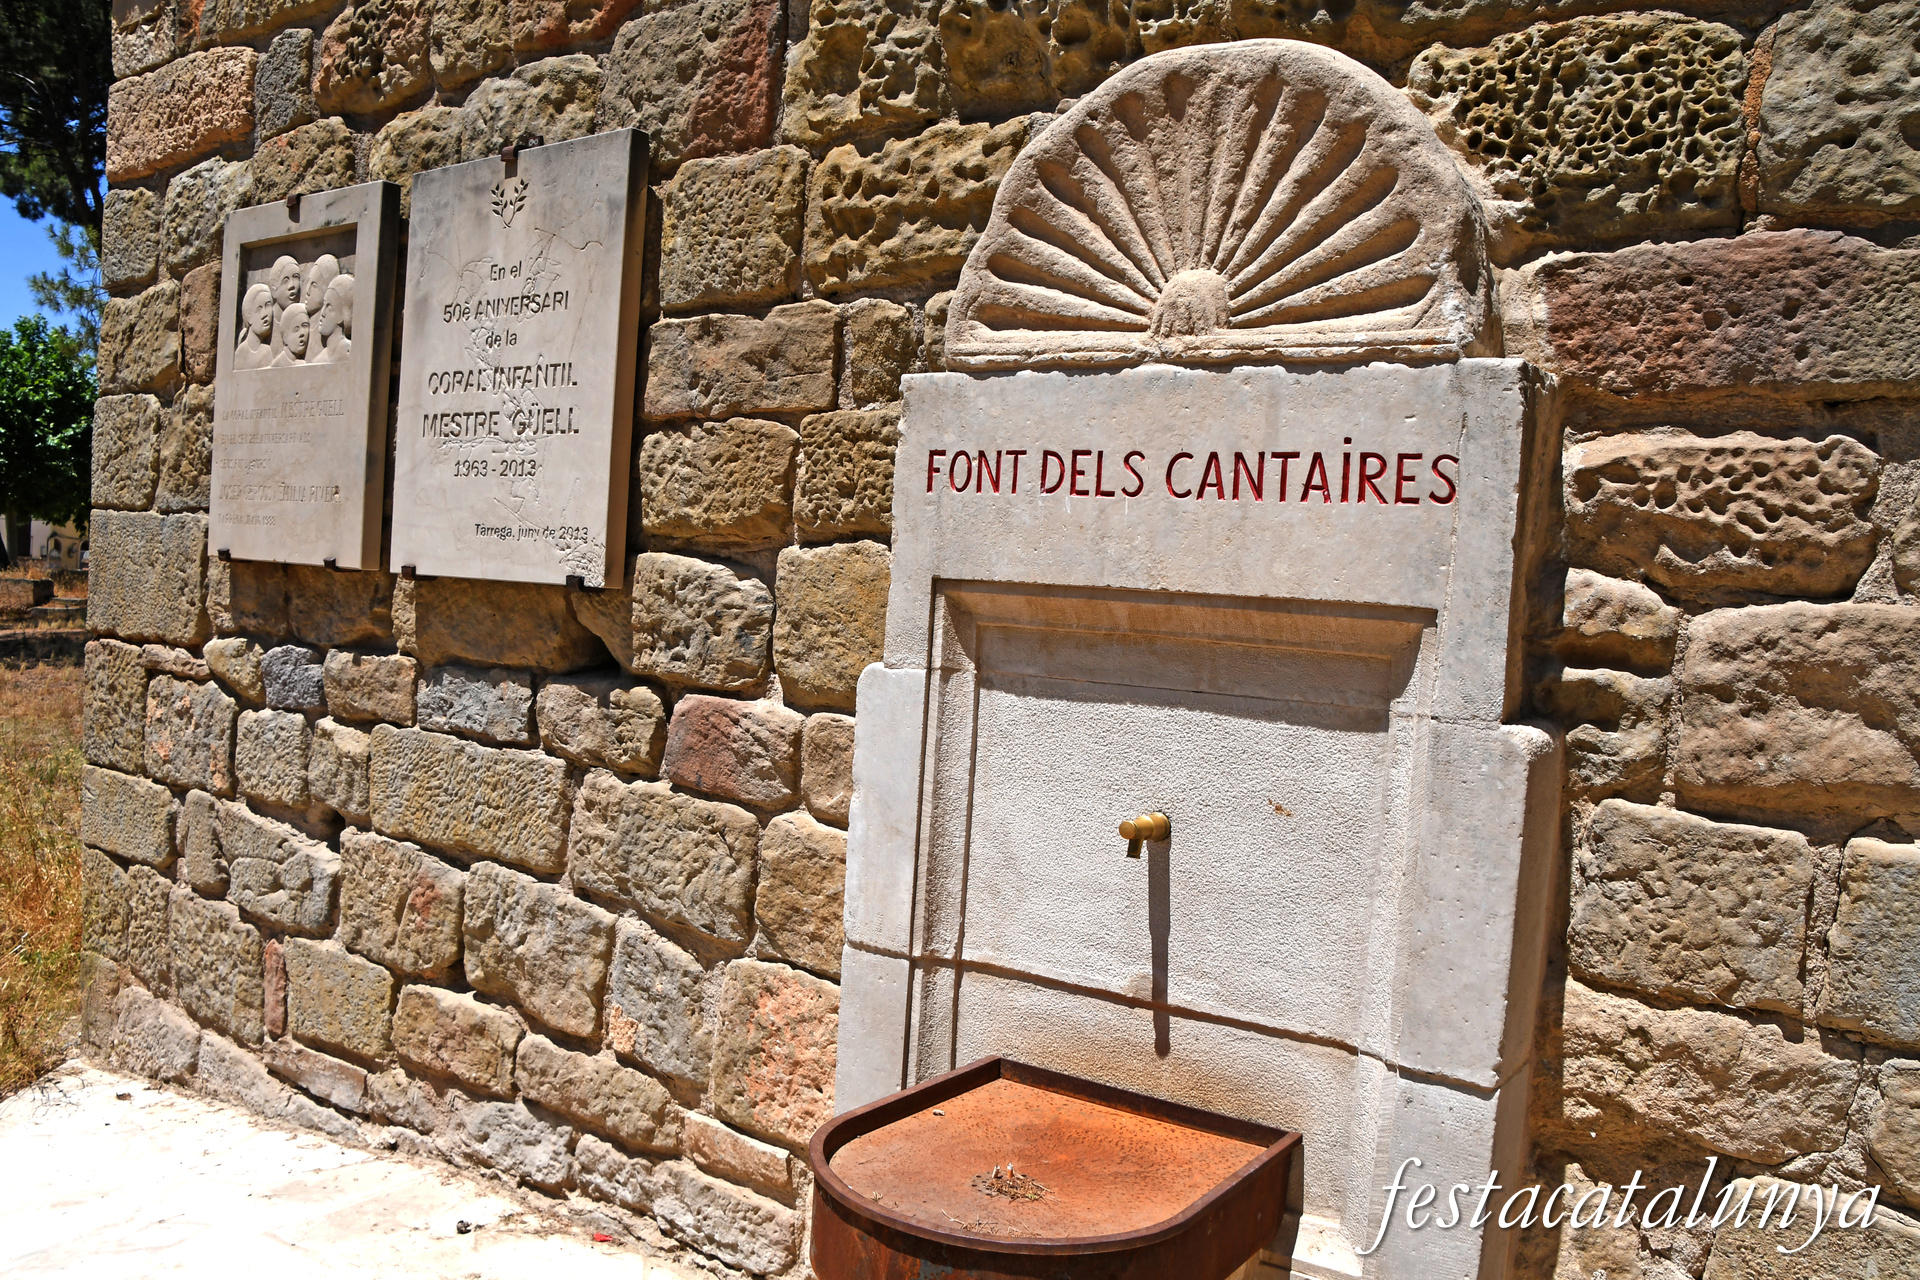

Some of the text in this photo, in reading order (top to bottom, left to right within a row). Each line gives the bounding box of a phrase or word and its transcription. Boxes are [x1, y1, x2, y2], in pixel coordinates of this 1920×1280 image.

[489, 260, 522, 281] En el
[474, 290, 569, 320] ANIVERSARI
[485, 329, 518, 349] de la
[428, 362, 578, 395] CORAL INFANTIL
[422, 402, 580, 439] MESTRE GÜELL
[453, 459, 488, 477] 1963
[499, 459, 537, 478] 2013
[926, 449, 1028, 496] FONT
[1040, 449, 1146, 499] DELS
[517, 525, 540, 542] juny
[542, 525, 556, 539] de
[558, 526, 589, 541] 2013
